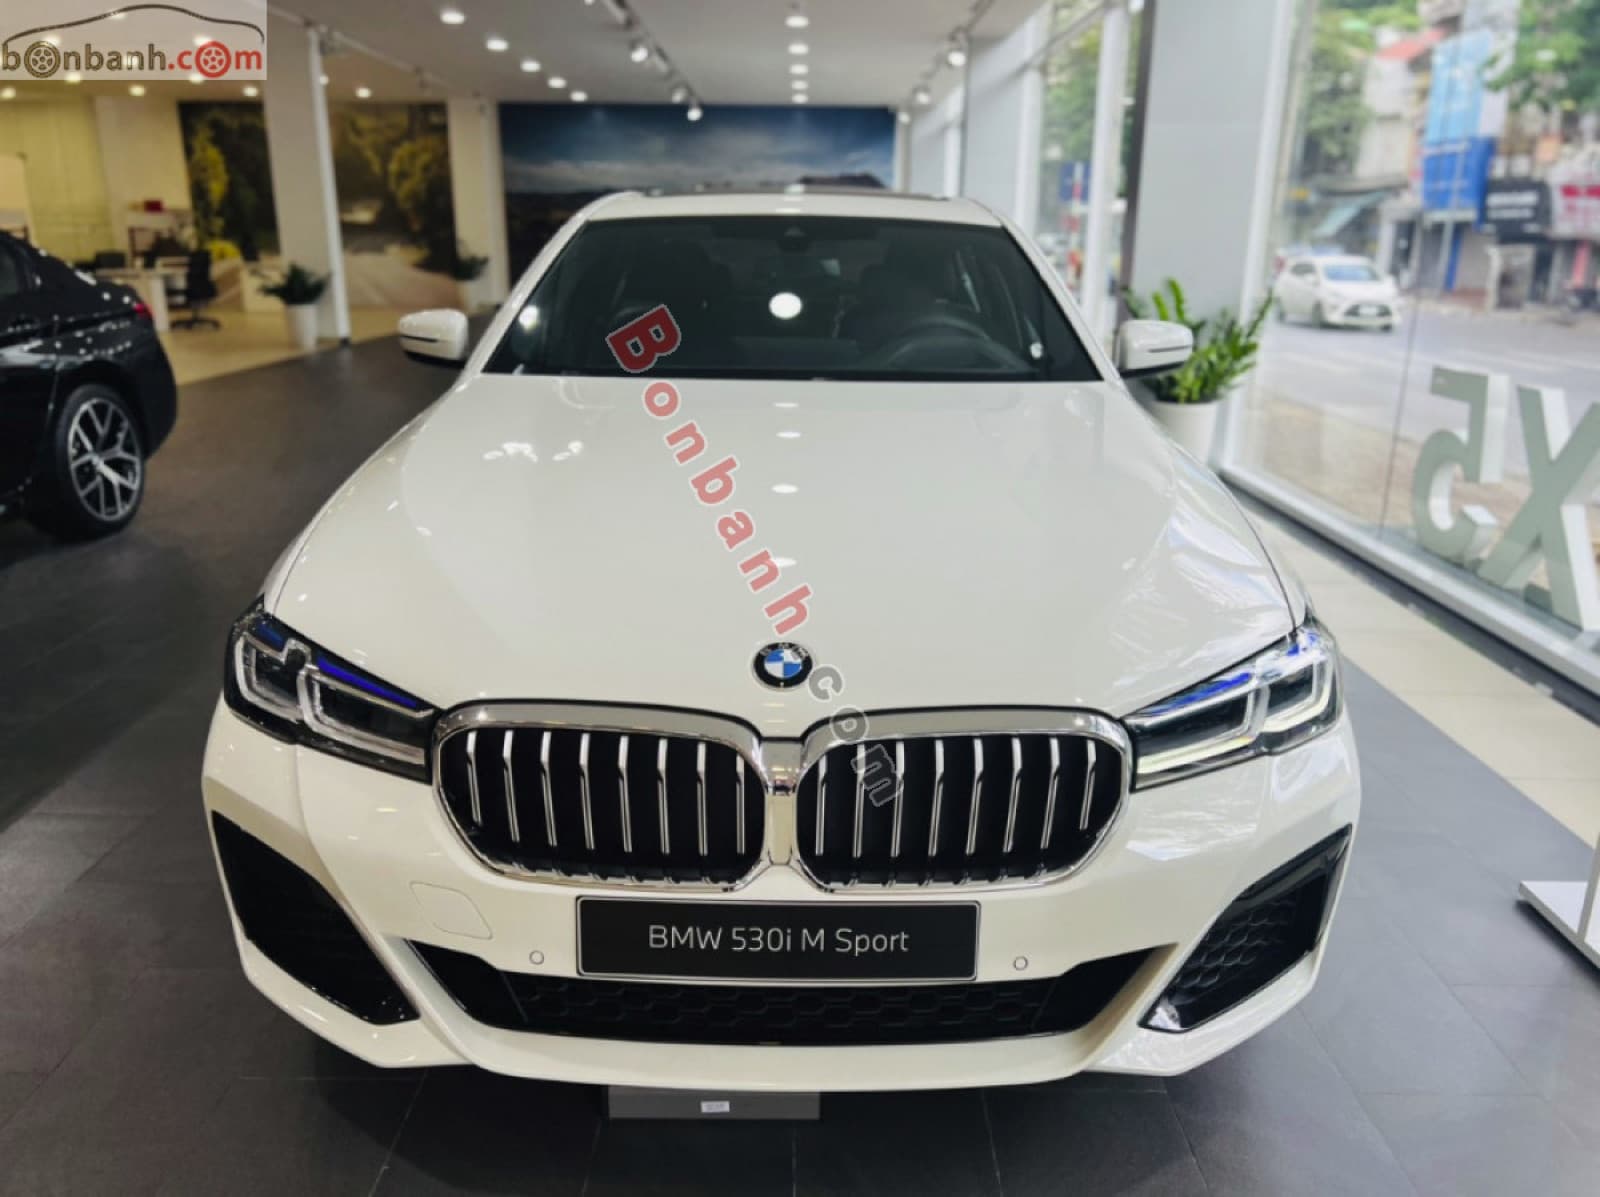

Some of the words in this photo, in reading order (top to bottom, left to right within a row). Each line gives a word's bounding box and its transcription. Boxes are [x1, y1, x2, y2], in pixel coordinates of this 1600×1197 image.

[648, 925, 722, 949] BMW
[731, 927, 792, 952] 530i
[801, 928, 825, 952] M
[835, 928, 909, 956] Sport
